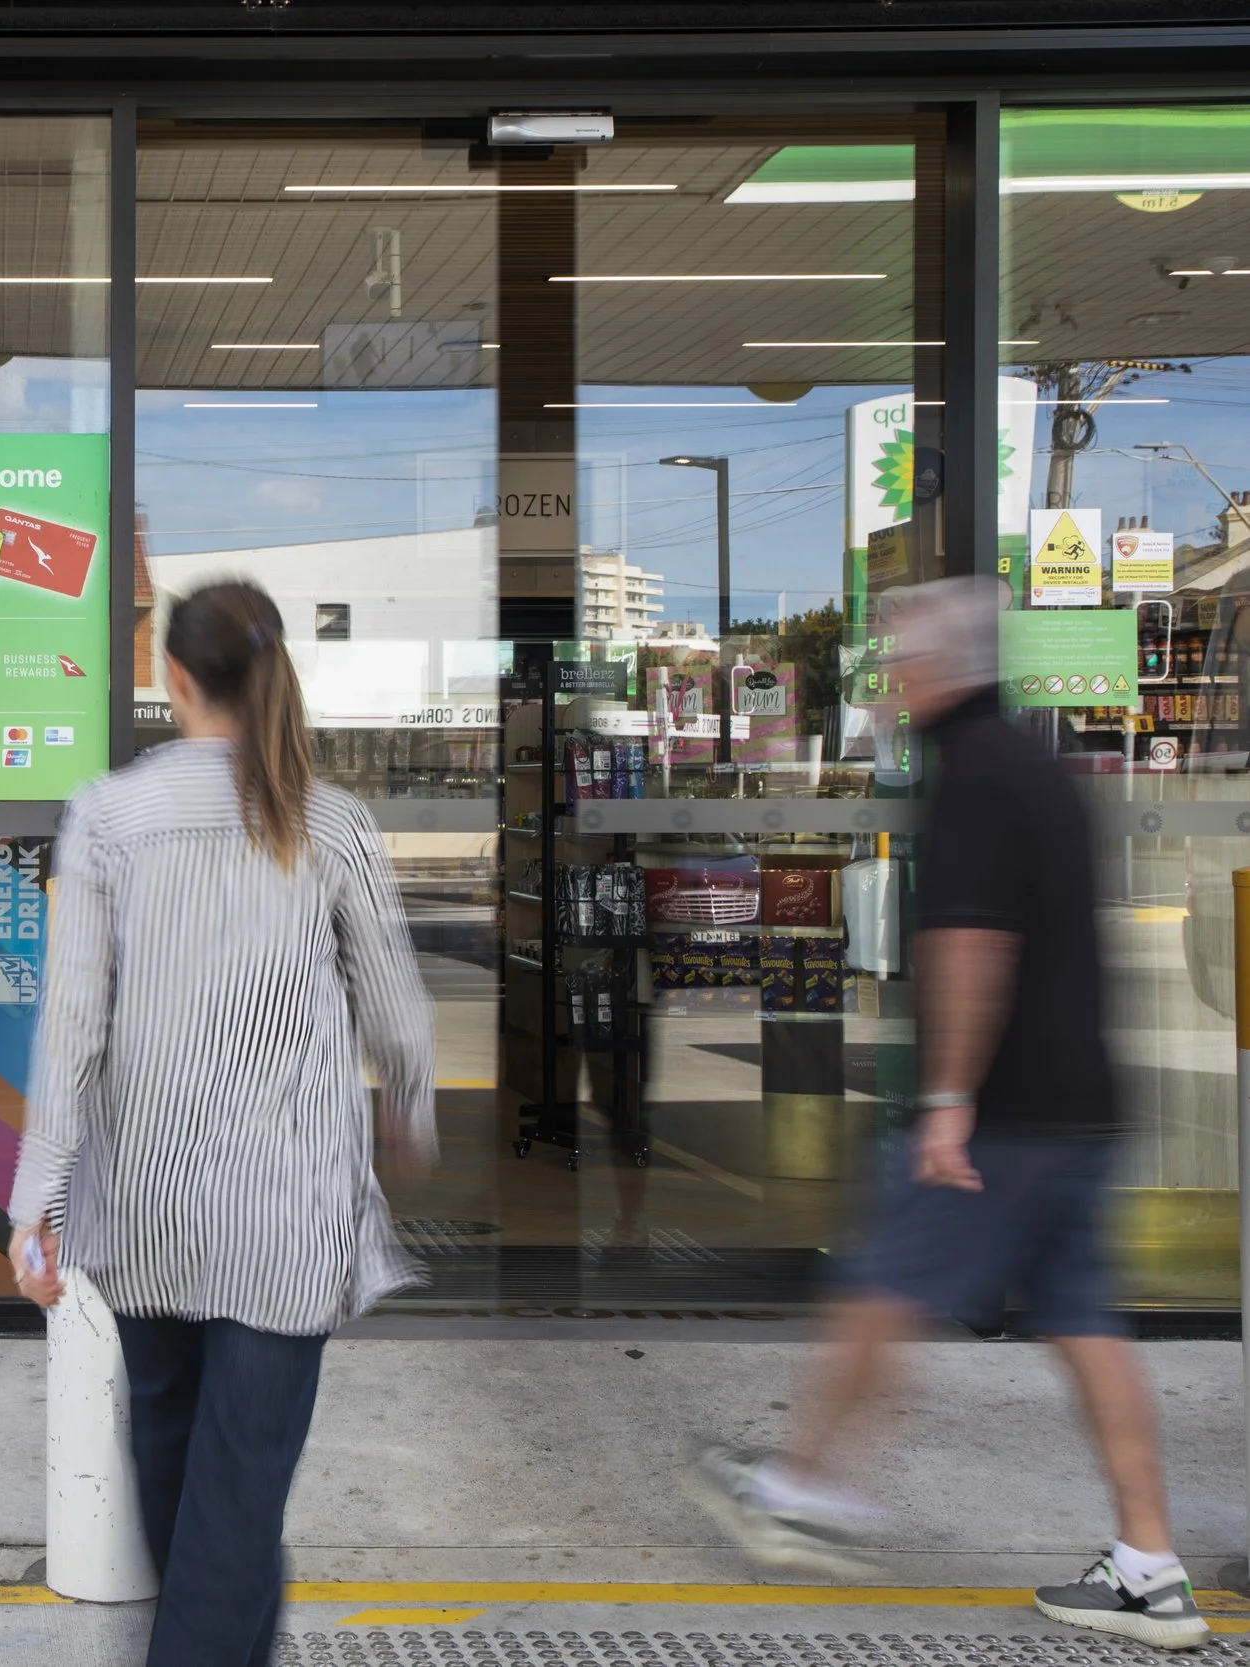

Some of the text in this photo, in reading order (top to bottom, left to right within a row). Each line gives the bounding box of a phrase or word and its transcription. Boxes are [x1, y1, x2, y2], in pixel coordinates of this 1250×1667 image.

[495, 494, 571, 517] ROZEN
[4, 515, 42, 531] QANTAS
[1041, 566, 1090, 574] WARNING
[3, 654, 57, 664] BUSINESS
[5, 667, 57, 677] REWARDS
[560, 668, 615, 680] brellerz
[18, 845, 40, 939] DRINK
